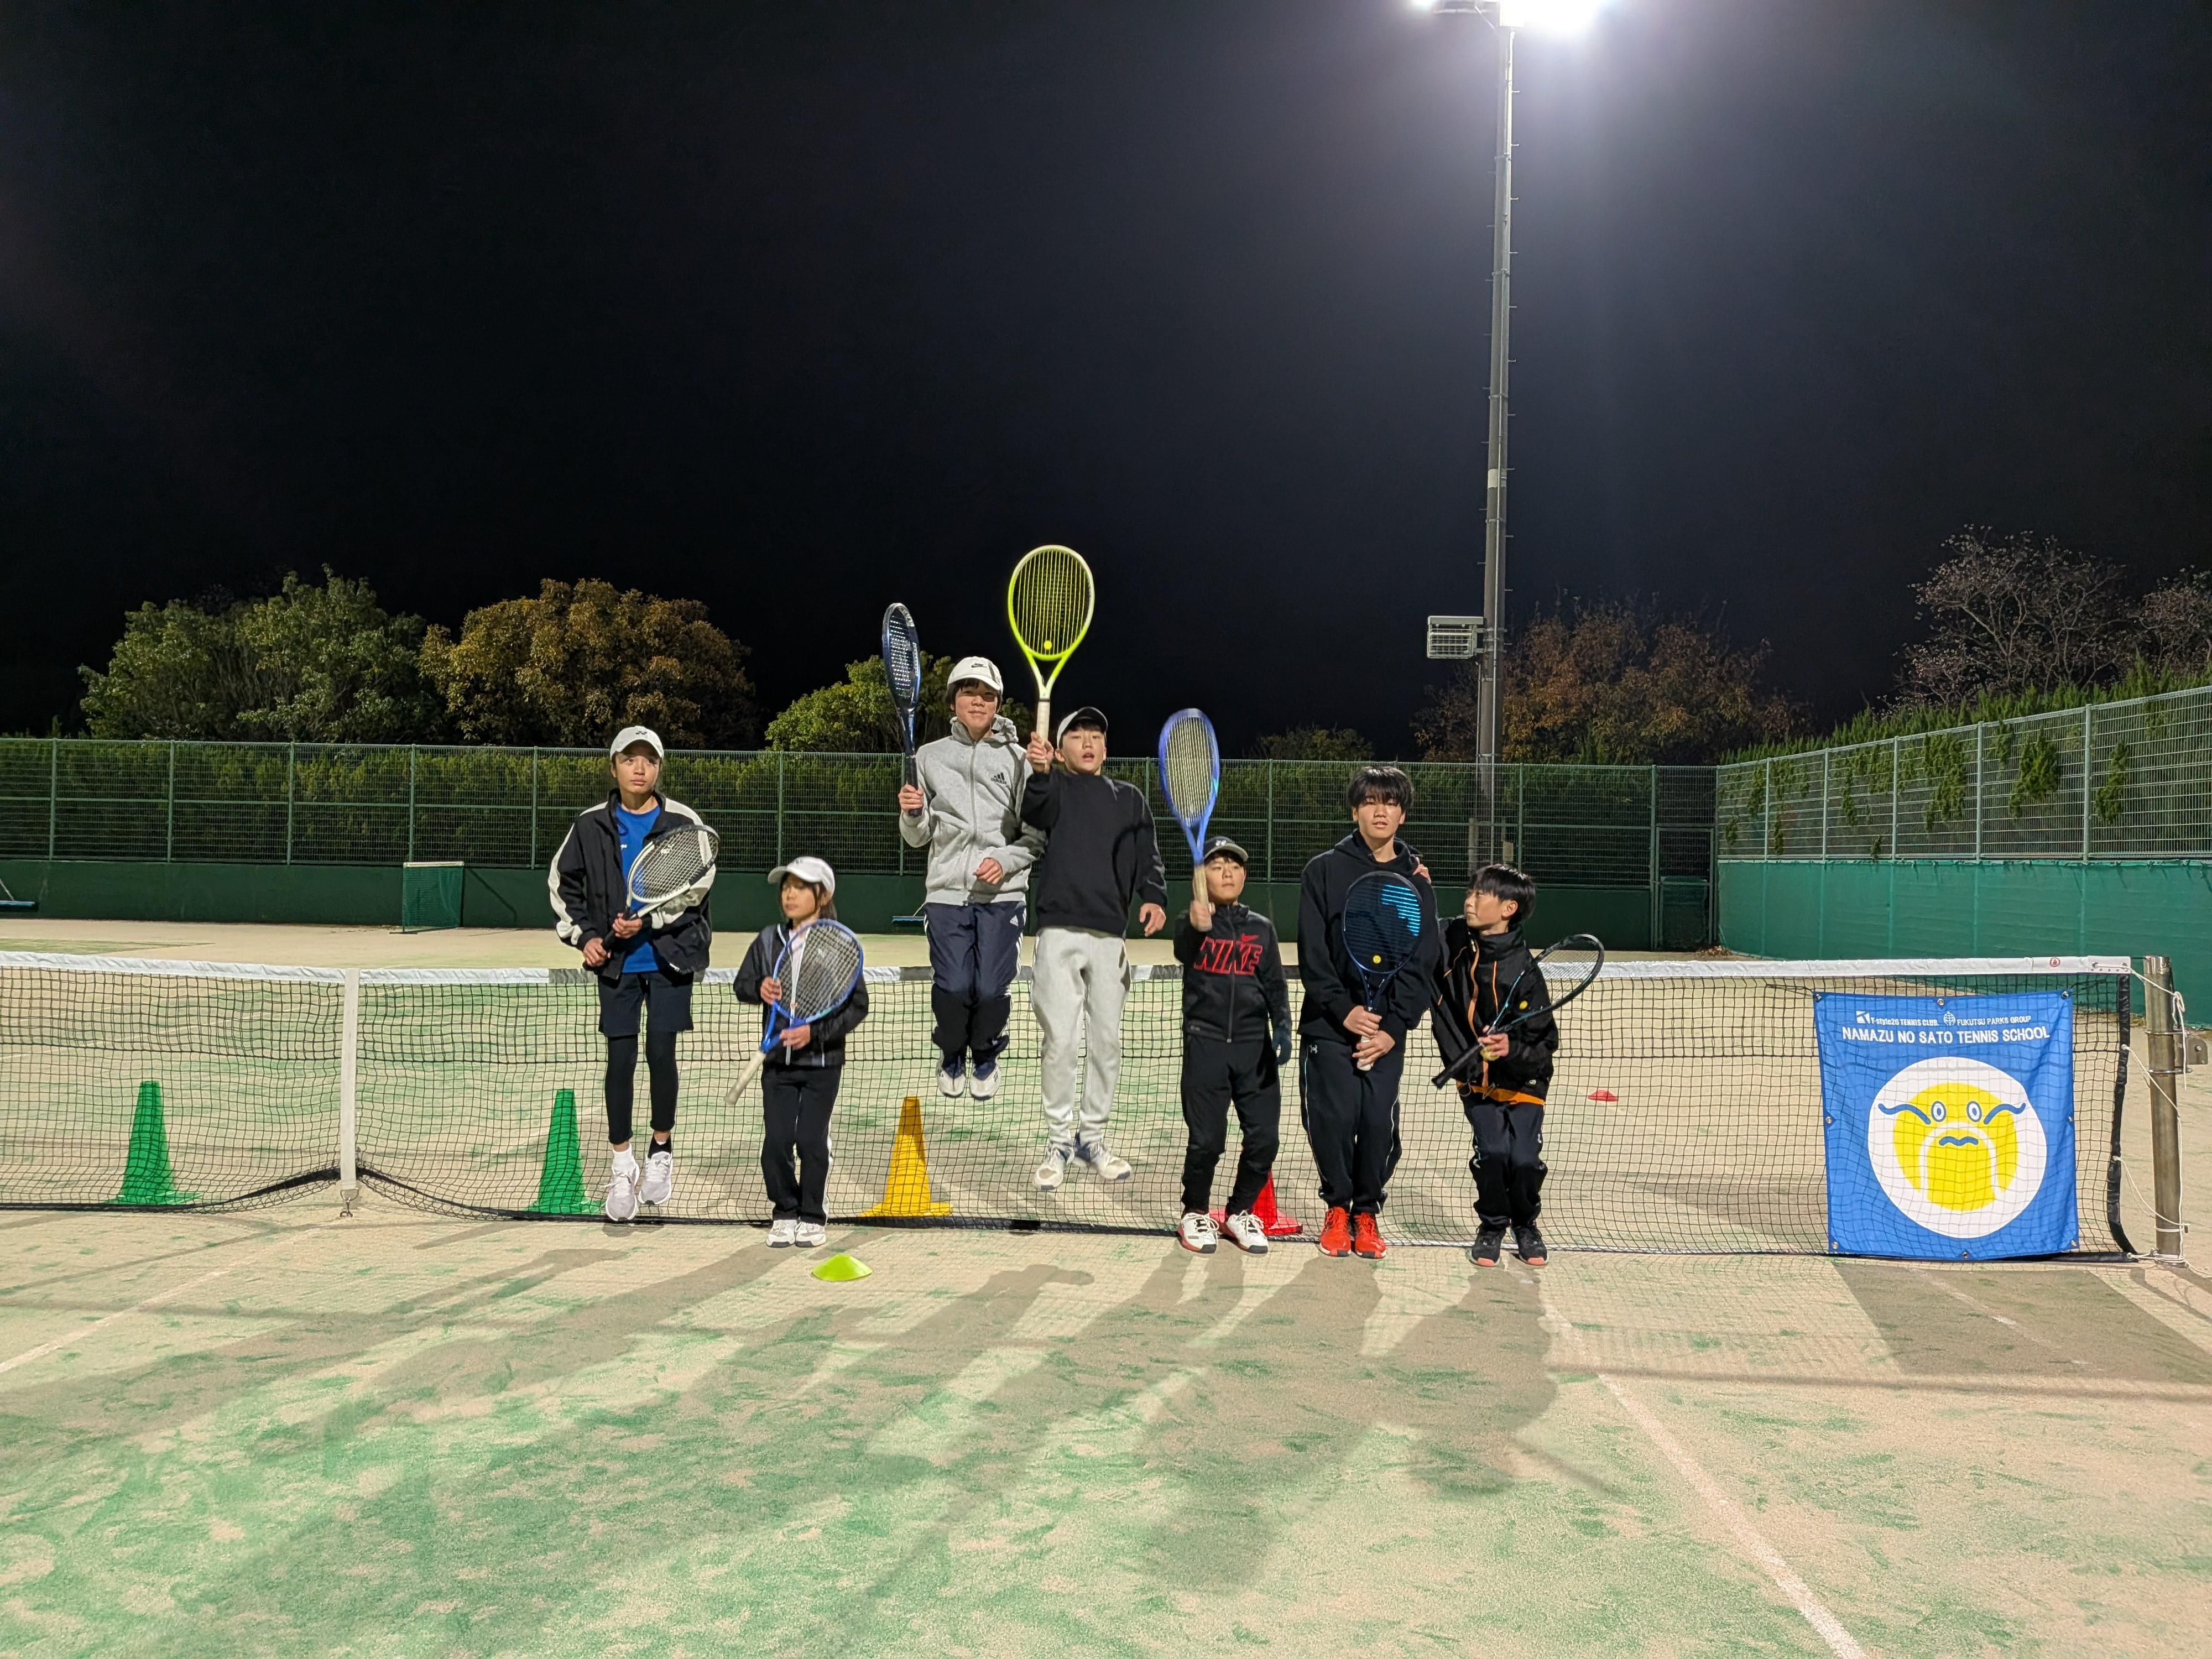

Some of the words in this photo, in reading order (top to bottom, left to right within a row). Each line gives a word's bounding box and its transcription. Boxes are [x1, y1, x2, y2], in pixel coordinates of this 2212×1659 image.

[1193, 936, 1263, 975] NIKE
[1957, 1018, 1986, 1026] FUKUTSU
[1987, 1016, 2009, 1025] PARKS
[2010, 1015, 2032, 1024] GROUP
[1841, 1026, 1894, 1043] NAMAZU
[1897, 1030, 1916, 1044] NO
[1918, 1031, 1953, 1044] SATO
[1956, 1029, 1999, 1044] TENNIS
[2002, 1026, 2051, 1042] SCHOOL
